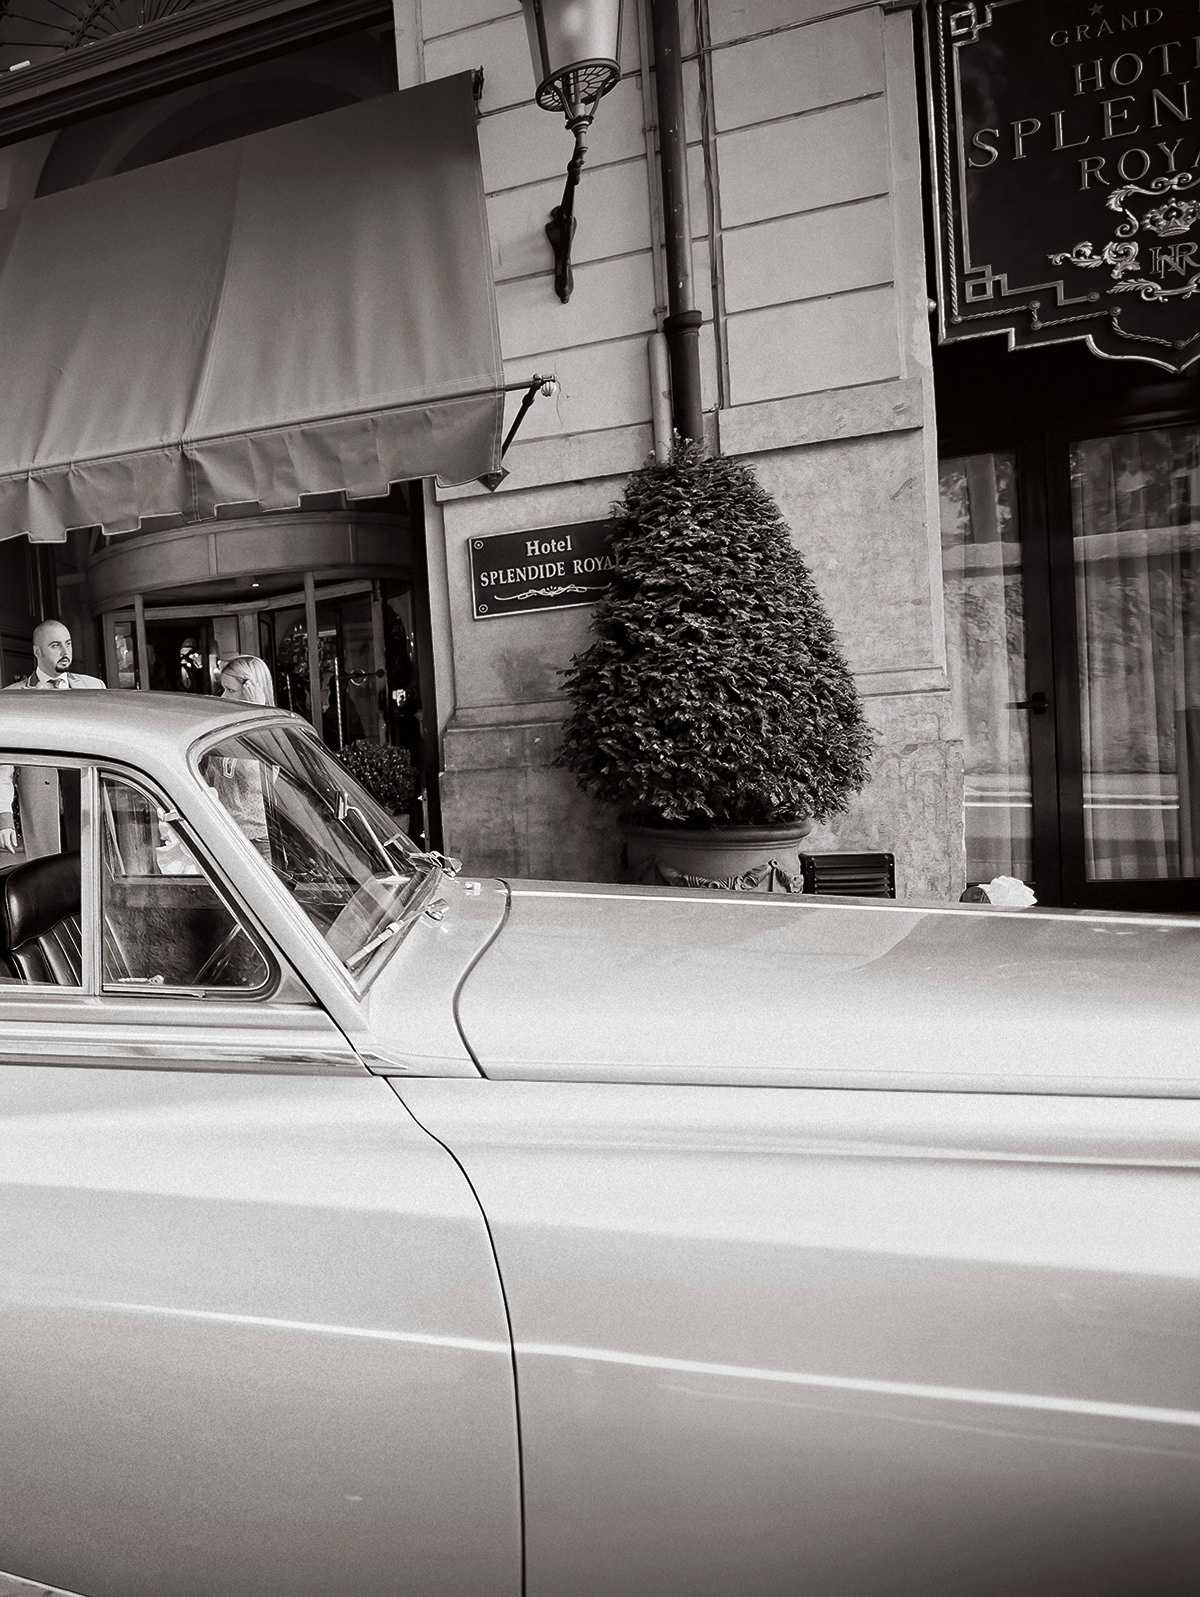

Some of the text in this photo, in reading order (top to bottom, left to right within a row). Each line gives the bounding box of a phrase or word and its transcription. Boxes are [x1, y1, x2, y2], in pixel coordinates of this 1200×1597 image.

[1050, 8, 1164, 47] GRAND
[968, 80, 1193, 168] SPLEN
[1078, 138, 1200, 191] ROY
[525, 535, 573, 557] Hotel
[480, 561, 566, 587] SPLENDIDE
